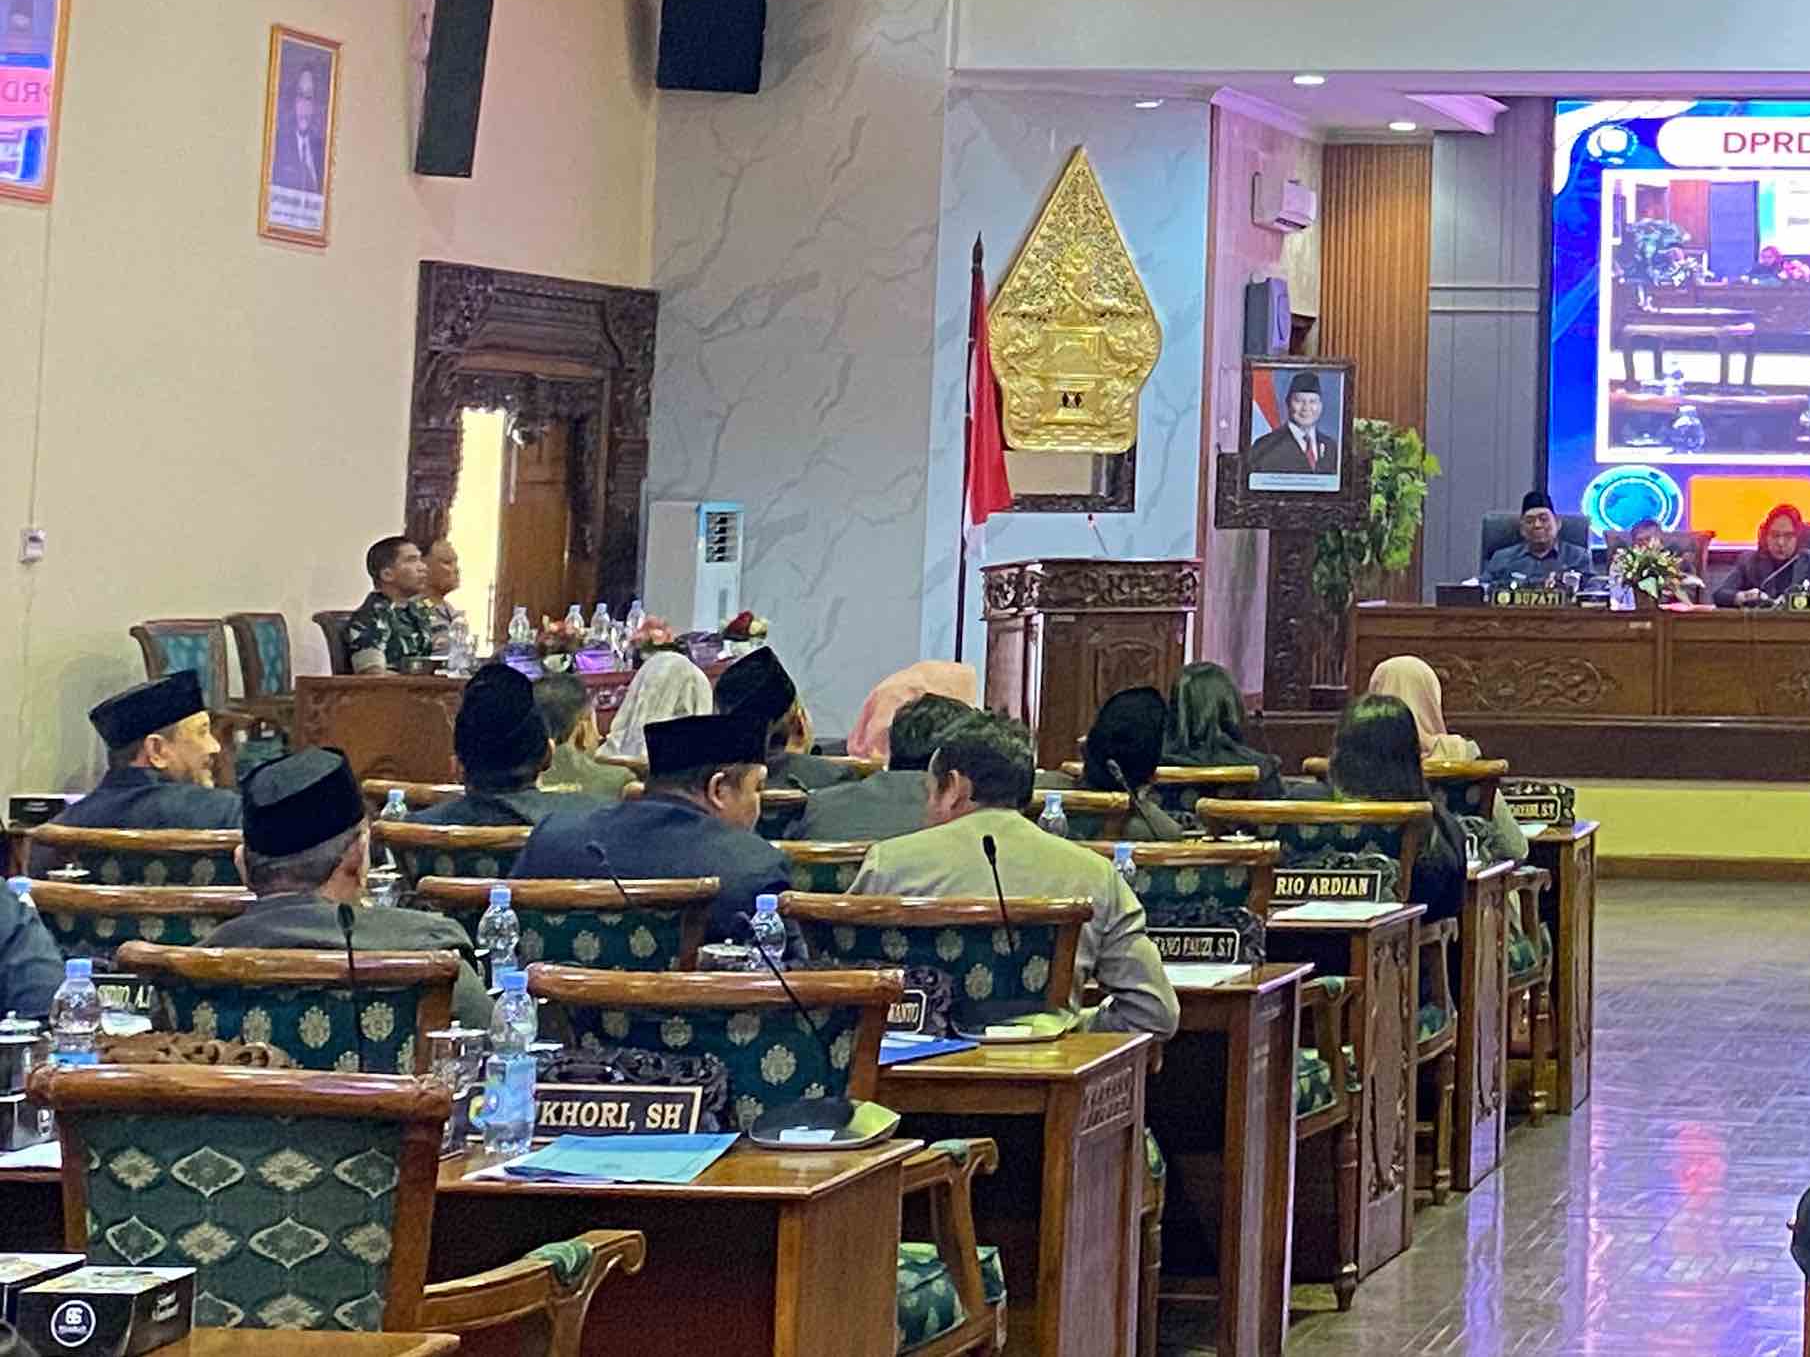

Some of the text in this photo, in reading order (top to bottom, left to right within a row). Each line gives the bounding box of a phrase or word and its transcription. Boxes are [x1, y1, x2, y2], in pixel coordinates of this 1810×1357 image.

[1513, 592, 1561, 605] BUPATI
[1274, 876, 1369, 896] RIO ARDIAN
[536, 1101, 685, 1132] KHORI, SH
